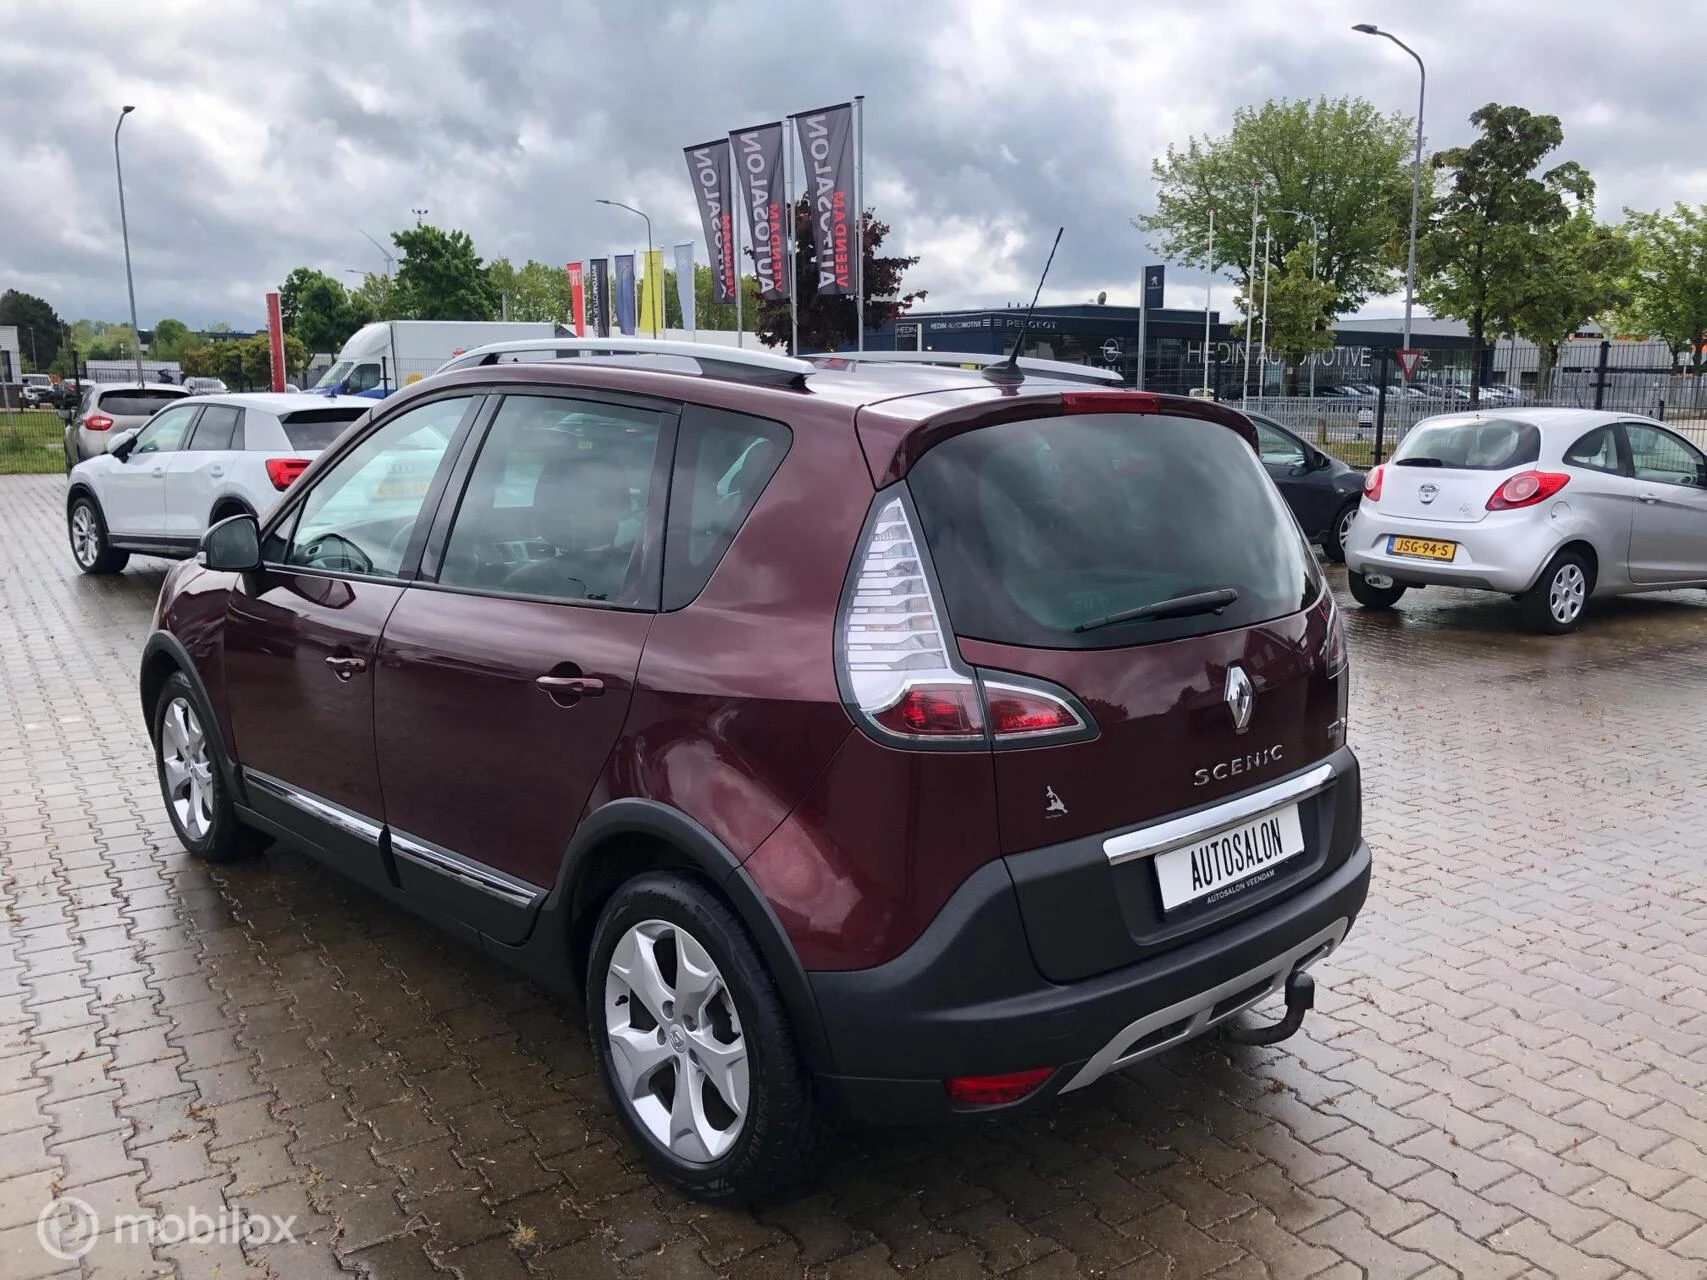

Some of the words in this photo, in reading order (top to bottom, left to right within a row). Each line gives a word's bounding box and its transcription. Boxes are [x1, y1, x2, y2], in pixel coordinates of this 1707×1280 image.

[1187, 340, 1248, 364] HEDIN
[1396, 539, 1449, 556] JSG-94-S
[1193, 744, 1283, 786] SCENIC
[1190, 816, 1283, 891] AUTOSALON
[1206, 882, 1246, 904] AUTOSALON
[1245, 869, 1275, 889] VEENDAM
